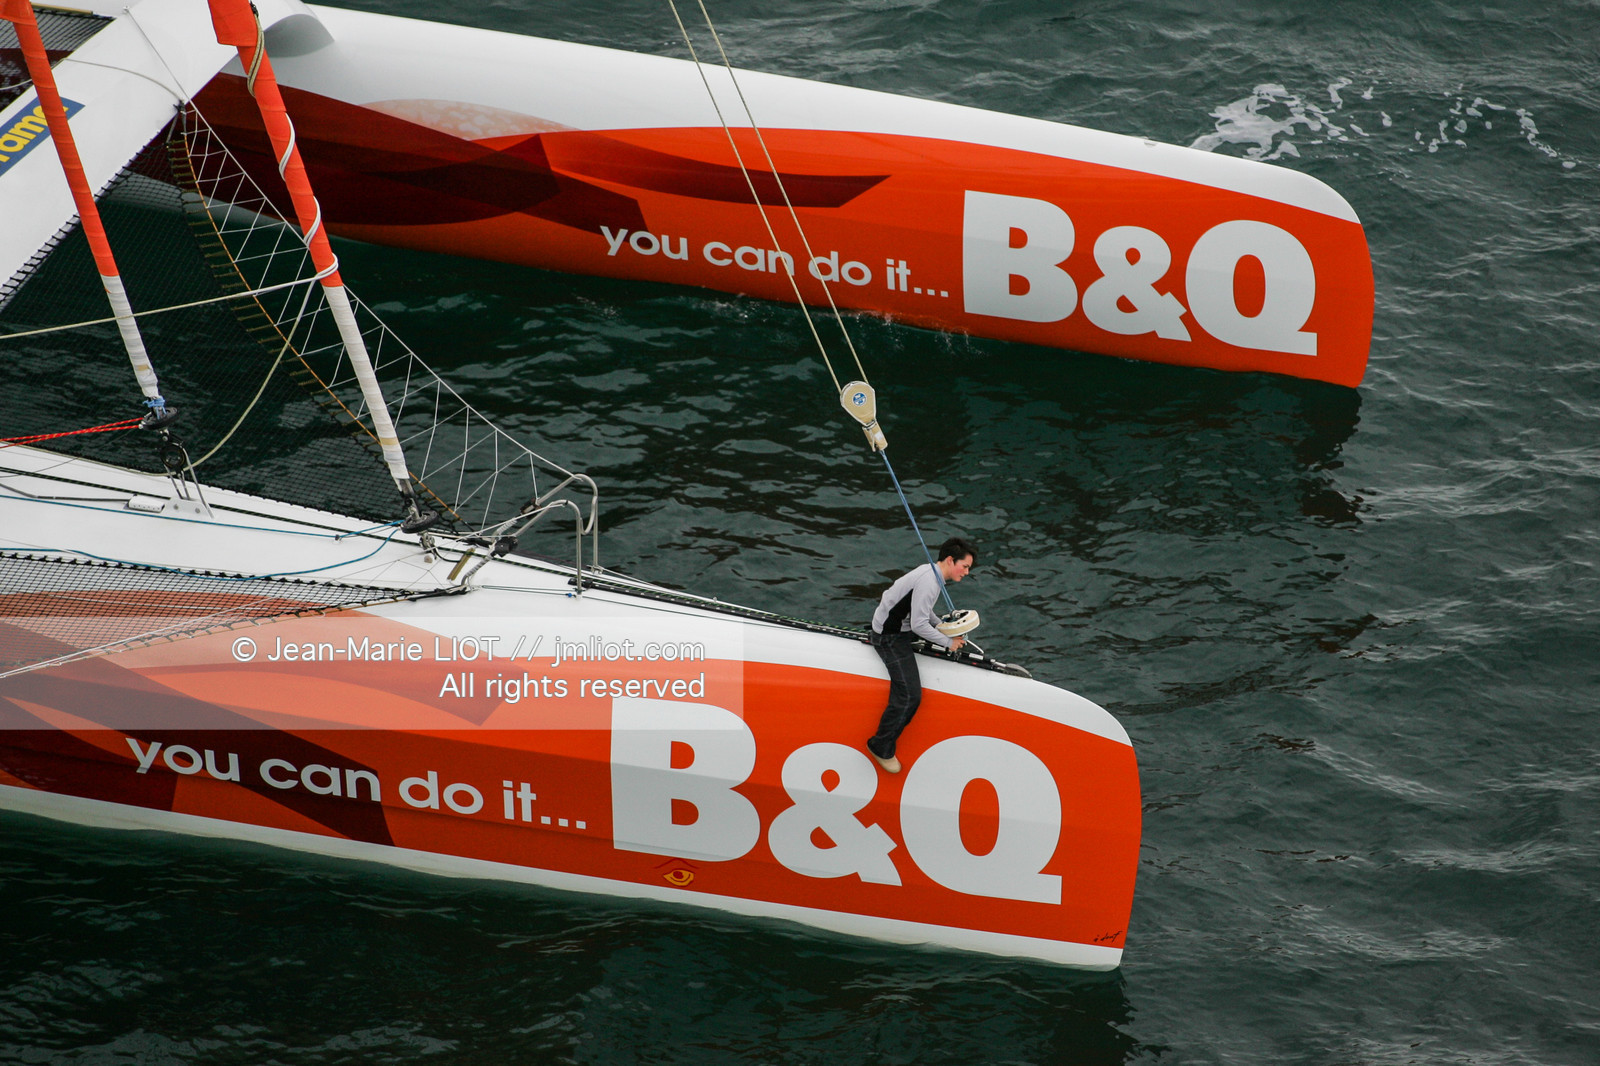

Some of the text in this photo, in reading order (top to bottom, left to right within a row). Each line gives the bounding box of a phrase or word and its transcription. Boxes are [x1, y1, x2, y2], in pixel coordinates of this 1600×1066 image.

[600, 225, 949, 298] you can do it...
[963, 190, 1318, 357] B&Q
[125, 737, 587, 830] you can do it...
[610, 697, 1063, 905] B&Q
